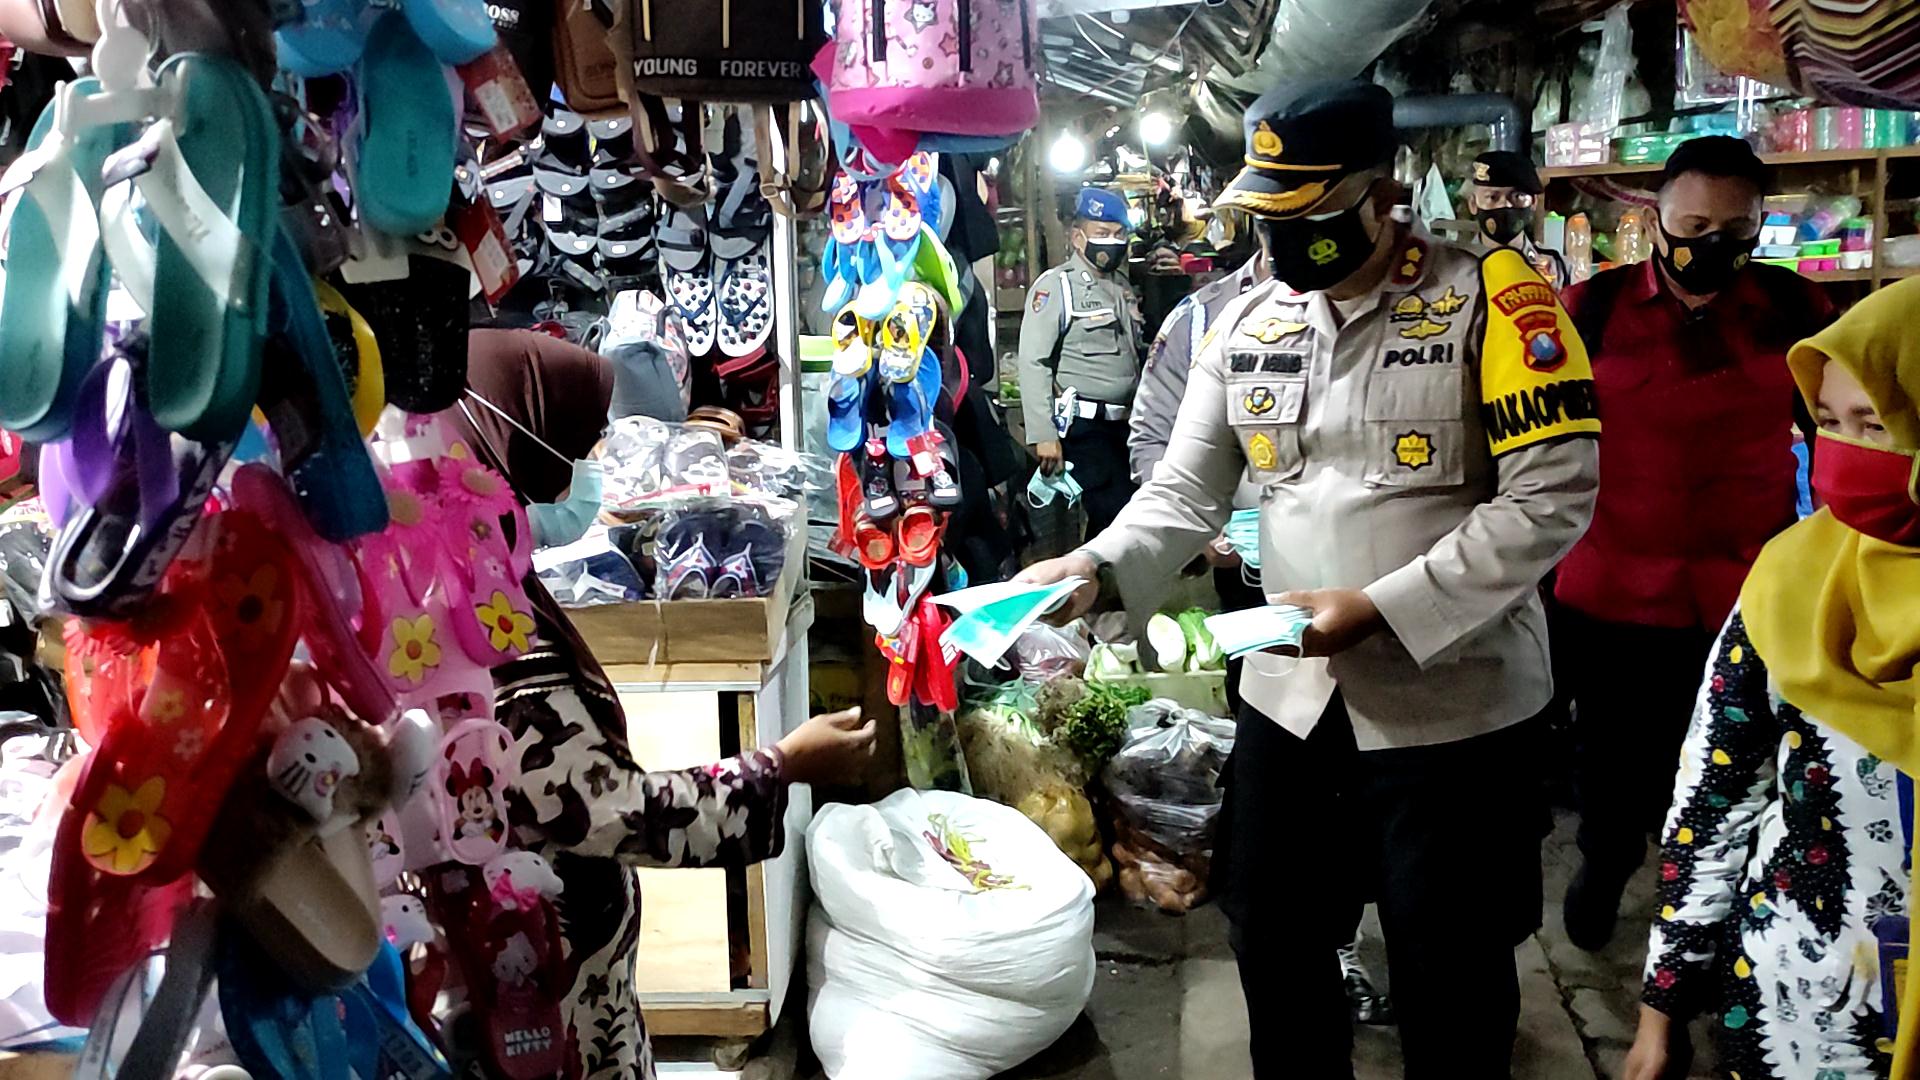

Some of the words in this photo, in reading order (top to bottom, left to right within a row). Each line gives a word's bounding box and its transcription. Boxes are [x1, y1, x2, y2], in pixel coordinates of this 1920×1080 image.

[633, 58, 698, 76] YOUNG
[720, 60, 801, 77] FOREVER
[1383, 343, 1454, 368] POLRI
[504, 1026, 551, 1044] HELLO
[506, 1039, 552, 1057] KITTY
